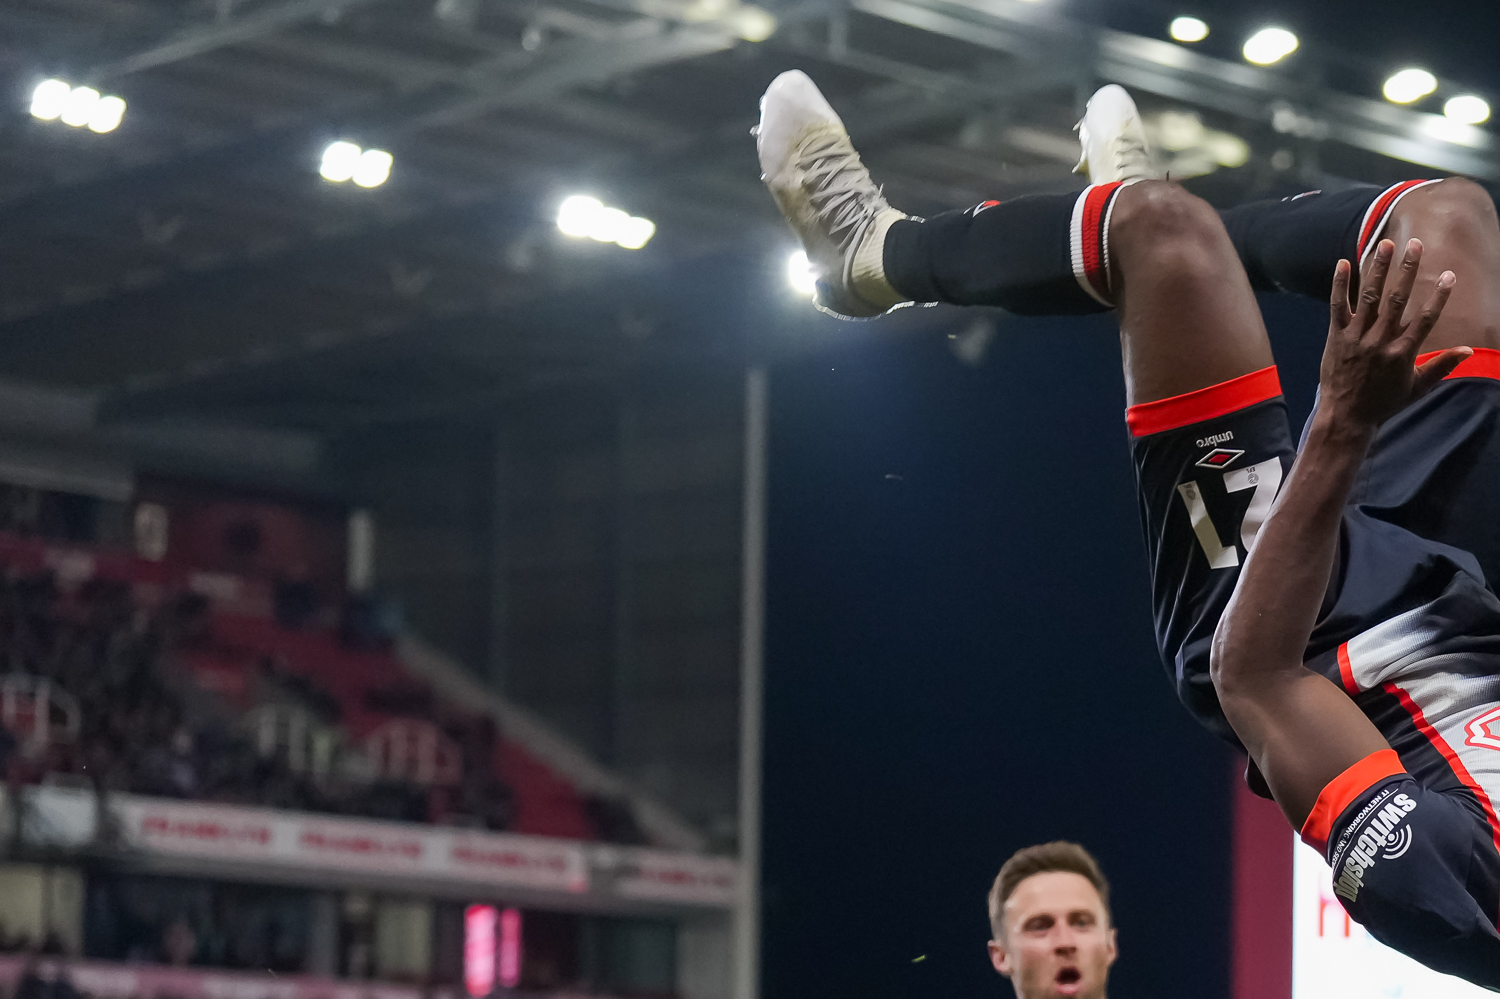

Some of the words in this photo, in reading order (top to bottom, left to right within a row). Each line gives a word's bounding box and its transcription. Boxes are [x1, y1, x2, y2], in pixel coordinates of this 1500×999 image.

[1195, 430, 1234, 448] umbro
[1381, 789, 1390, 797] IT
[1343, 795, 1383, 839] NETWORKING
[1337, 838, 1347, 853] AND
